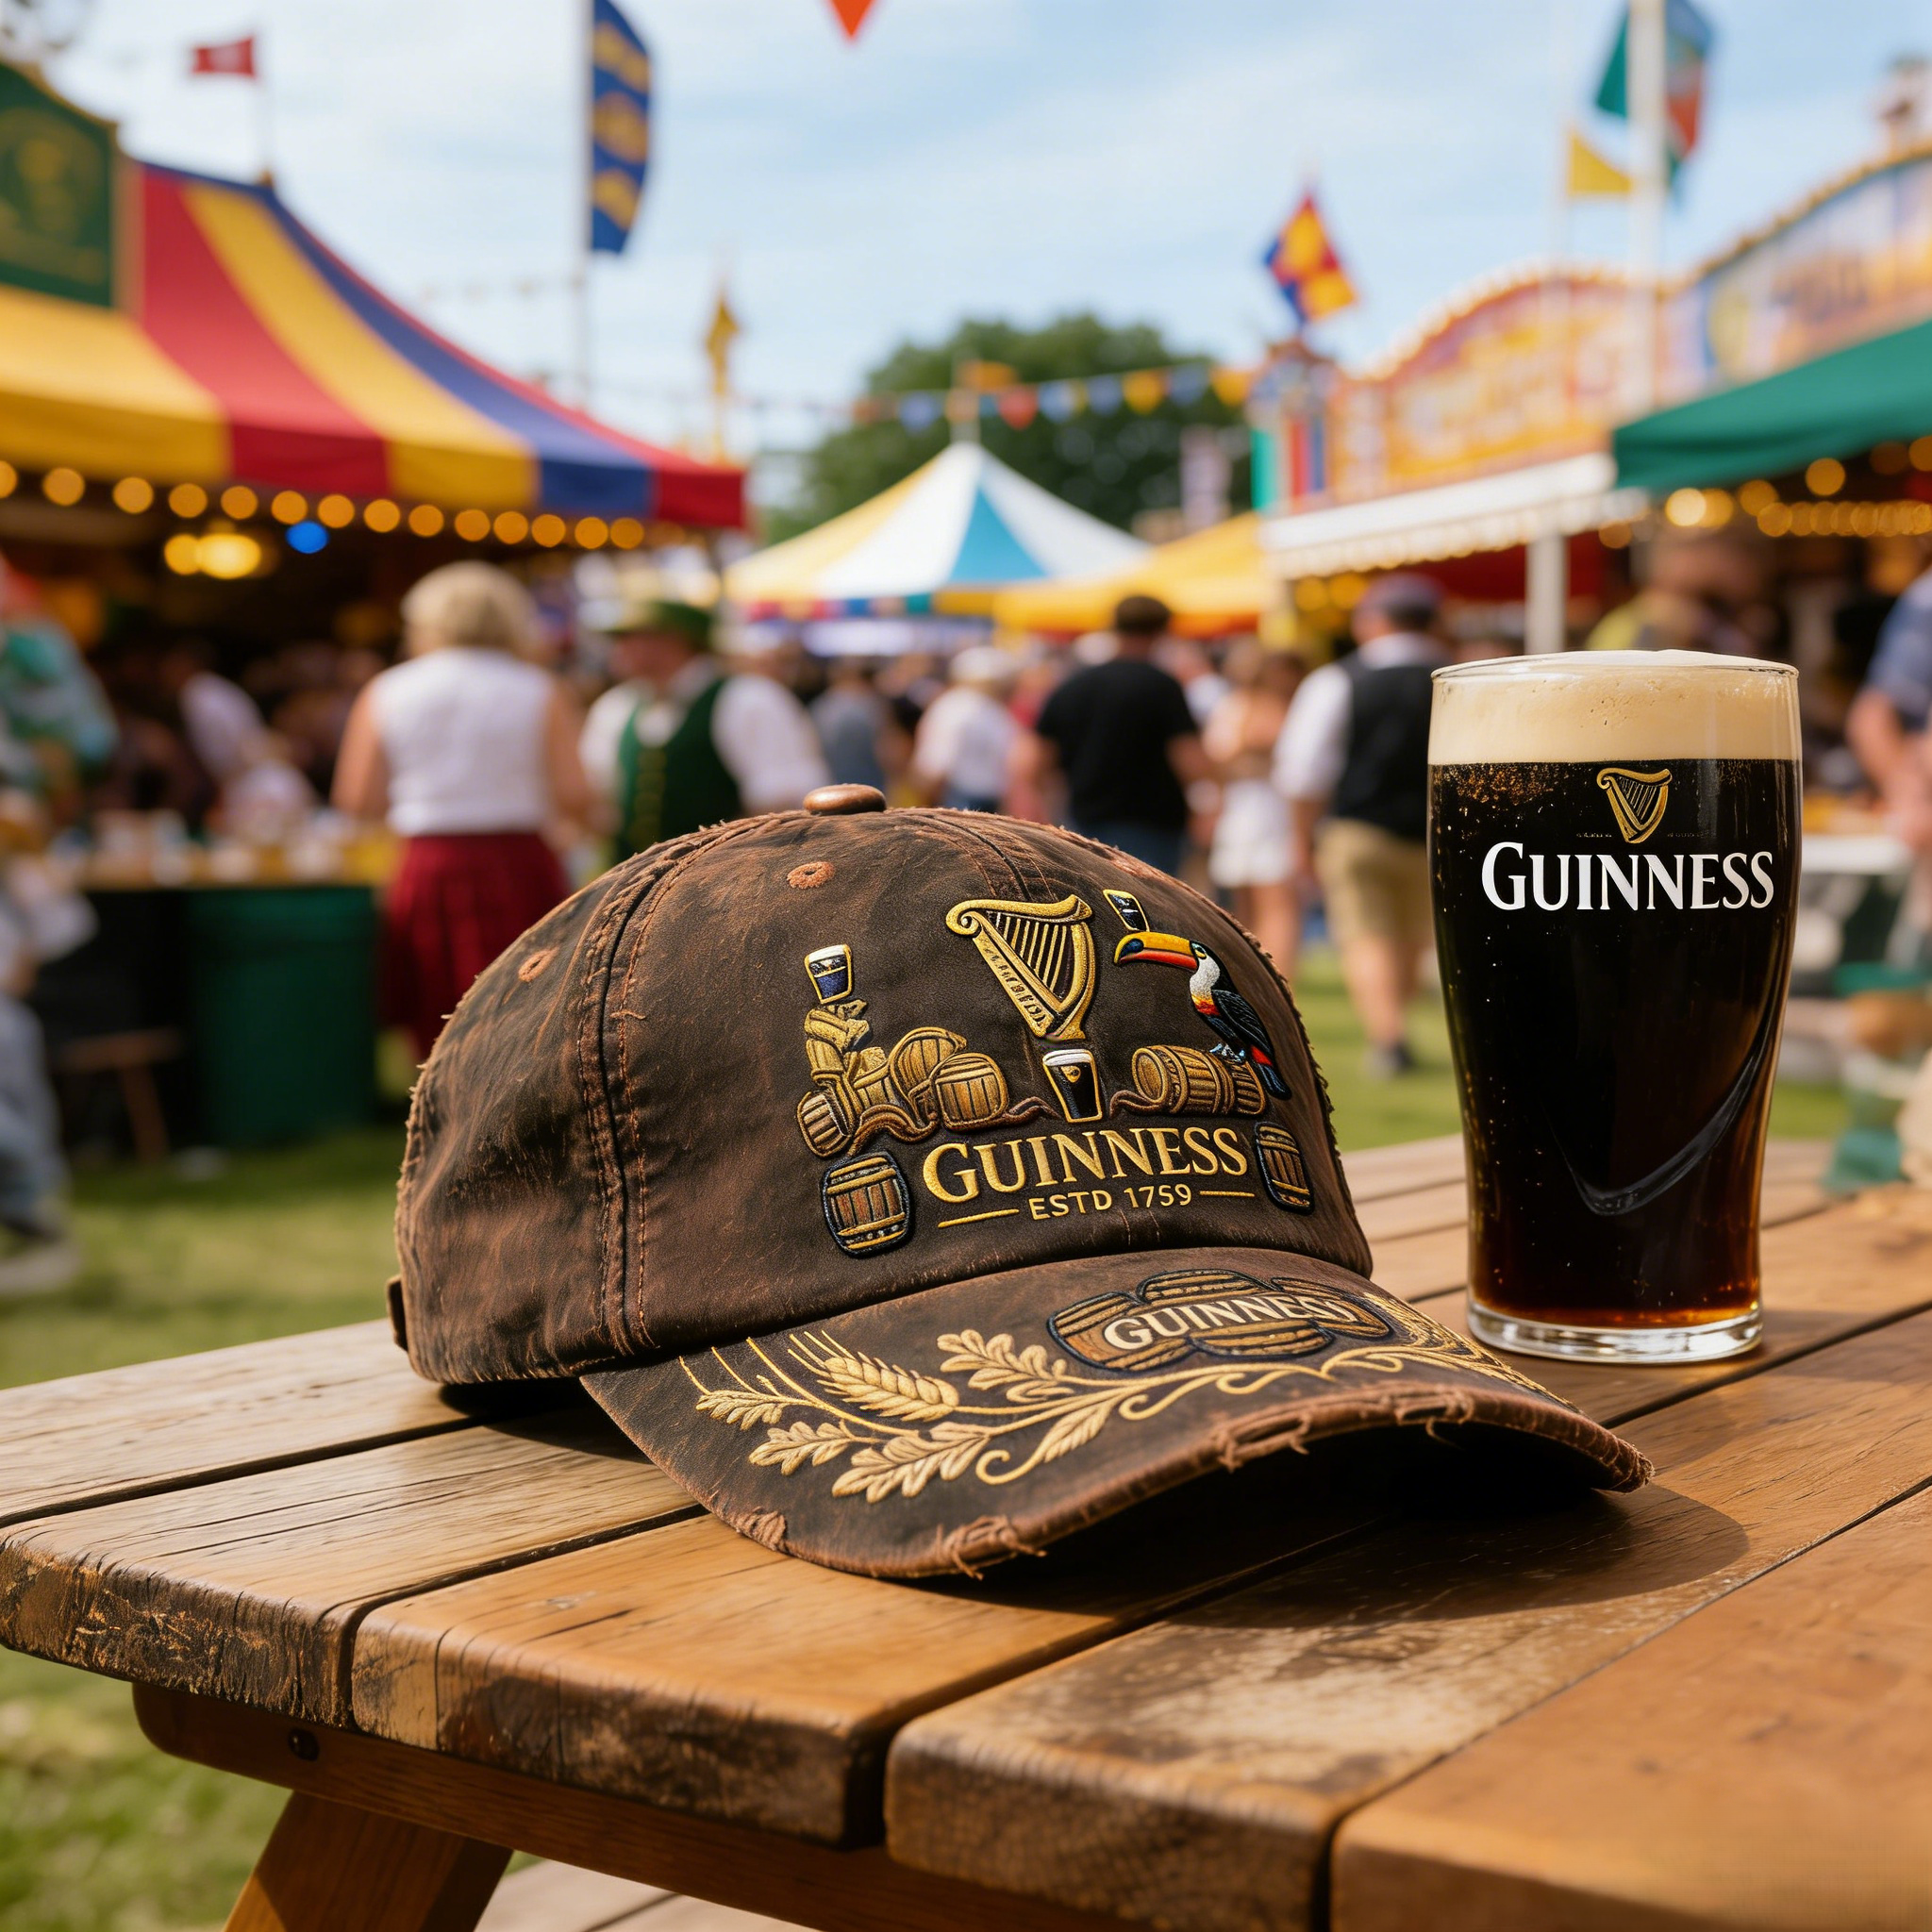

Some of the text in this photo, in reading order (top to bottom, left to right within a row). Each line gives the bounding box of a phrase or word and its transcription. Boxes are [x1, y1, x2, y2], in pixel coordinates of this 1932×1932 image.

[1482, 841, 1774, 911] GUINNESS
[923, 1126, 1248, 1203] GUINNESS
[1028, 1183, 1191, 1221] ESTD 1759
[1104, 1295, 1357, 1350] GUINNESS
